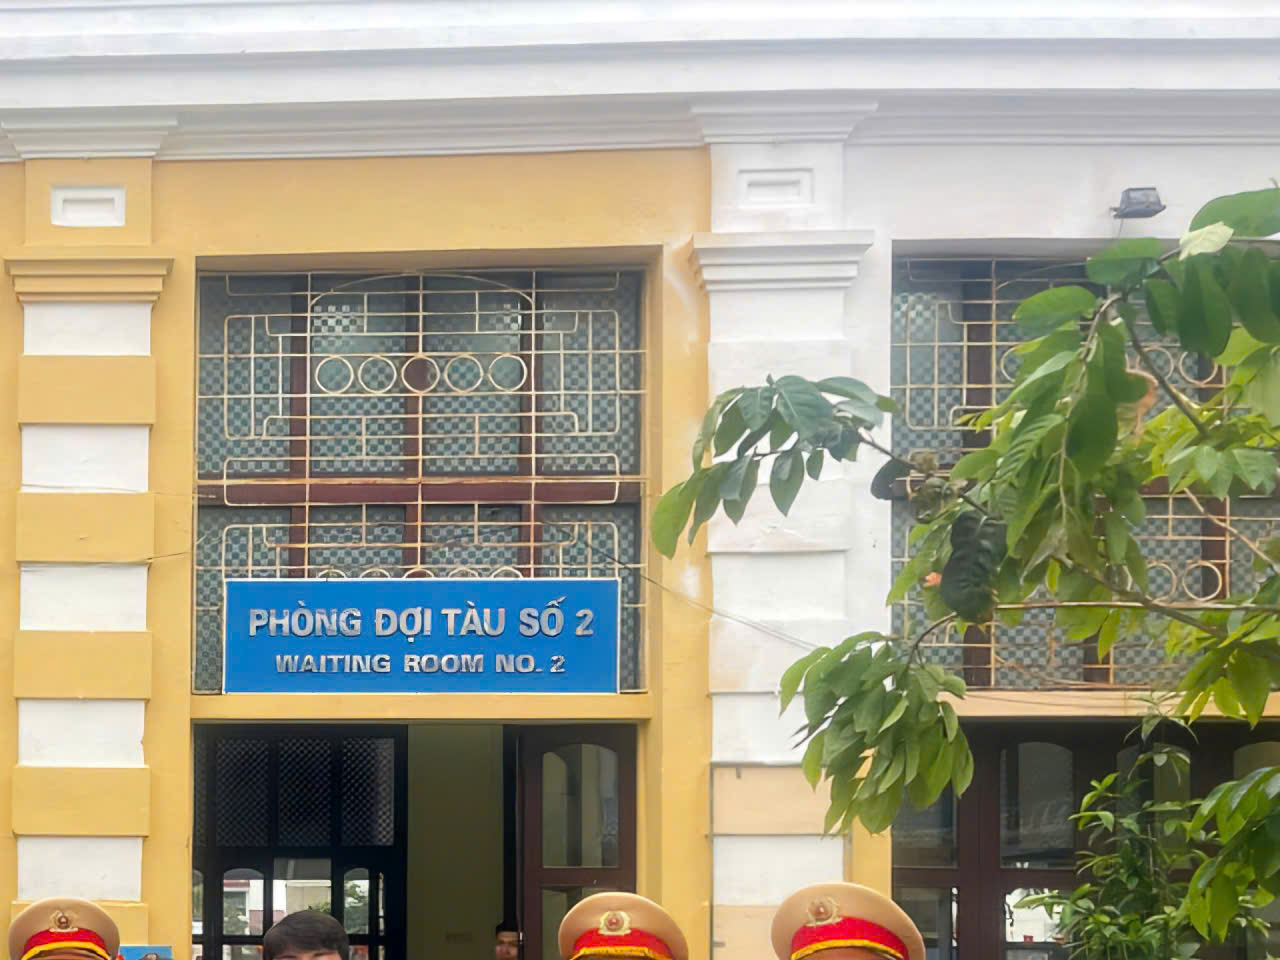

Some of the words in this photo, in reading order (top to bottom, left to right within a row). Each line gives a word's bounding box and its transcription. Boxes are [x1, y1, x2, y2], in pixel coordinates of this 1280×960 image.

[249, 600, 362, 637] PHÒNG
[375, 606, 432, 643] ĐỢI
[441, 600, 506, 637] TÀU
[519, 595, 568, 637] SỐ
[575, 608, 594, 636] 2
[275, 655, 391, 673] WAITING
[404, 655, 484, 673] ROOM
[495, 655, 544, 673] NO.
[549, 655, 566, 673] 2
